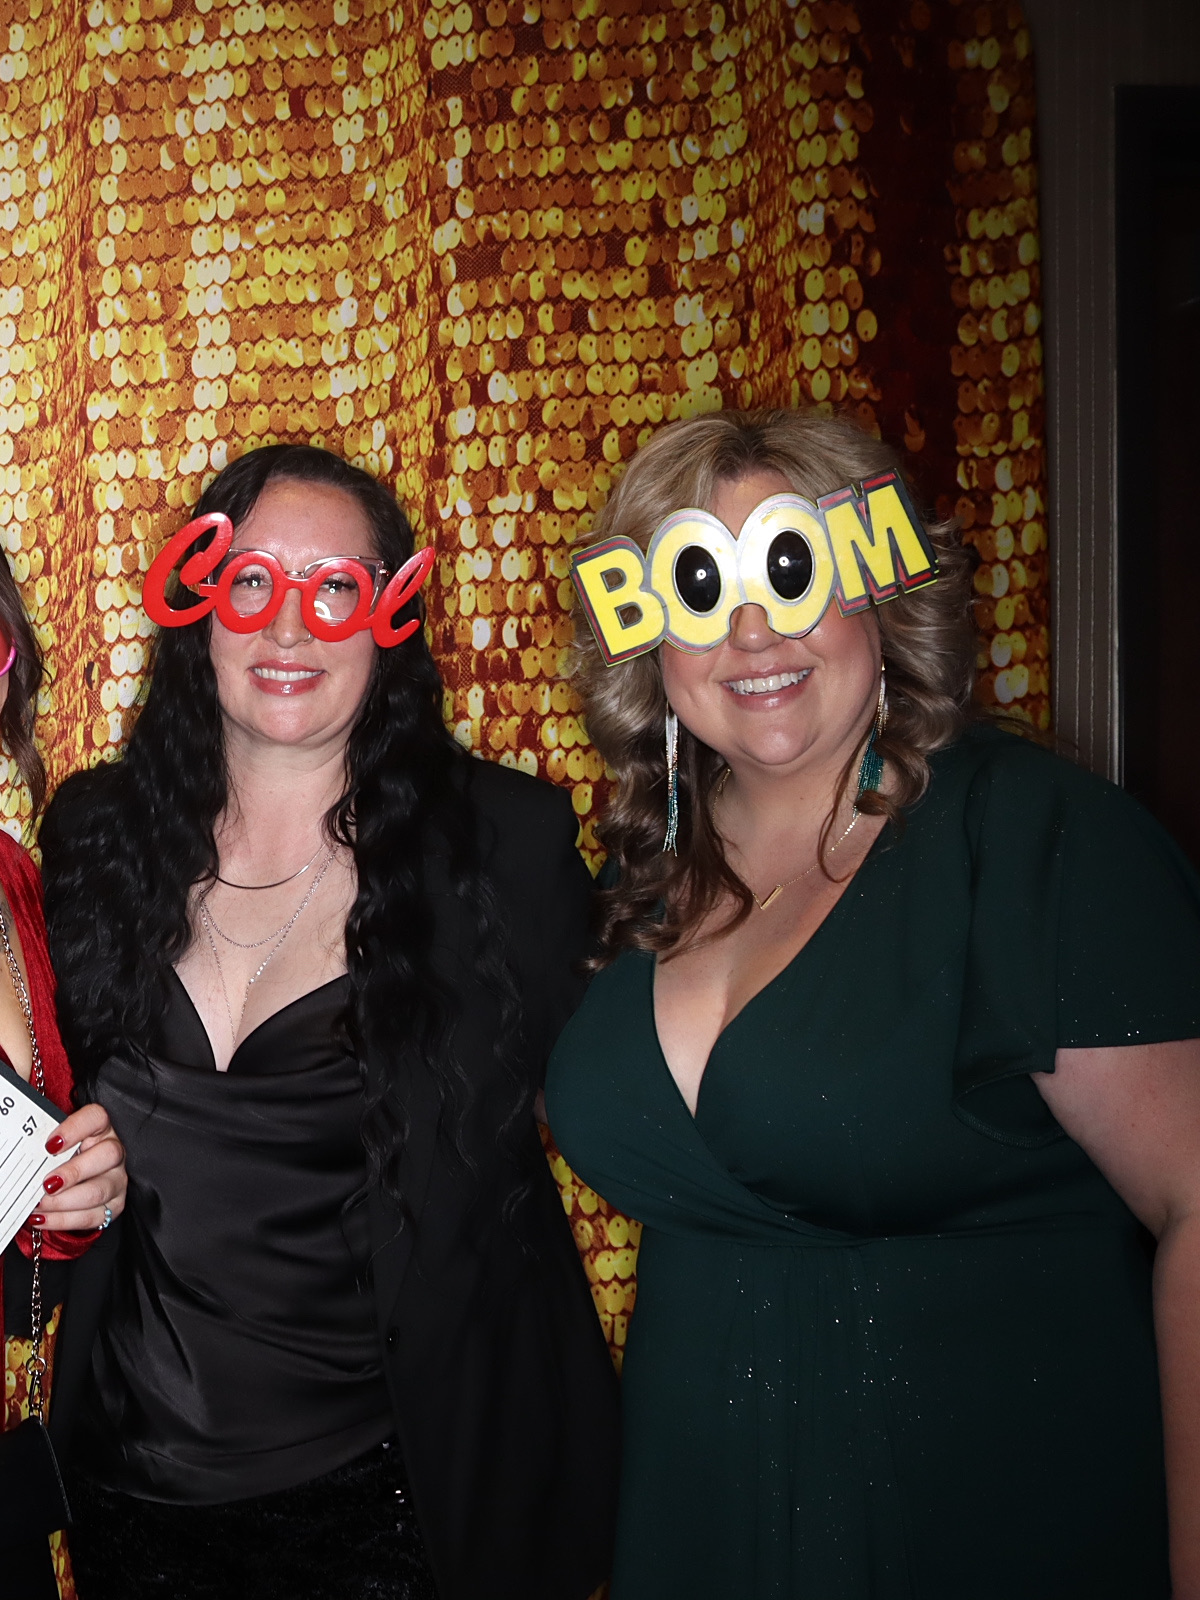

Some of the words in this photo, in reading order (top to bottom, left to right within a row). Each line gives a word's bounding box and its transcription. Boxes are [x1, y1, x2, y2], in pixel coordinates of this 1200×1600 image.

[142, 512, 435, 648] Cool
[570, 470, 938, 665] BOOM
[22, 1115, 38, 1136] 57
